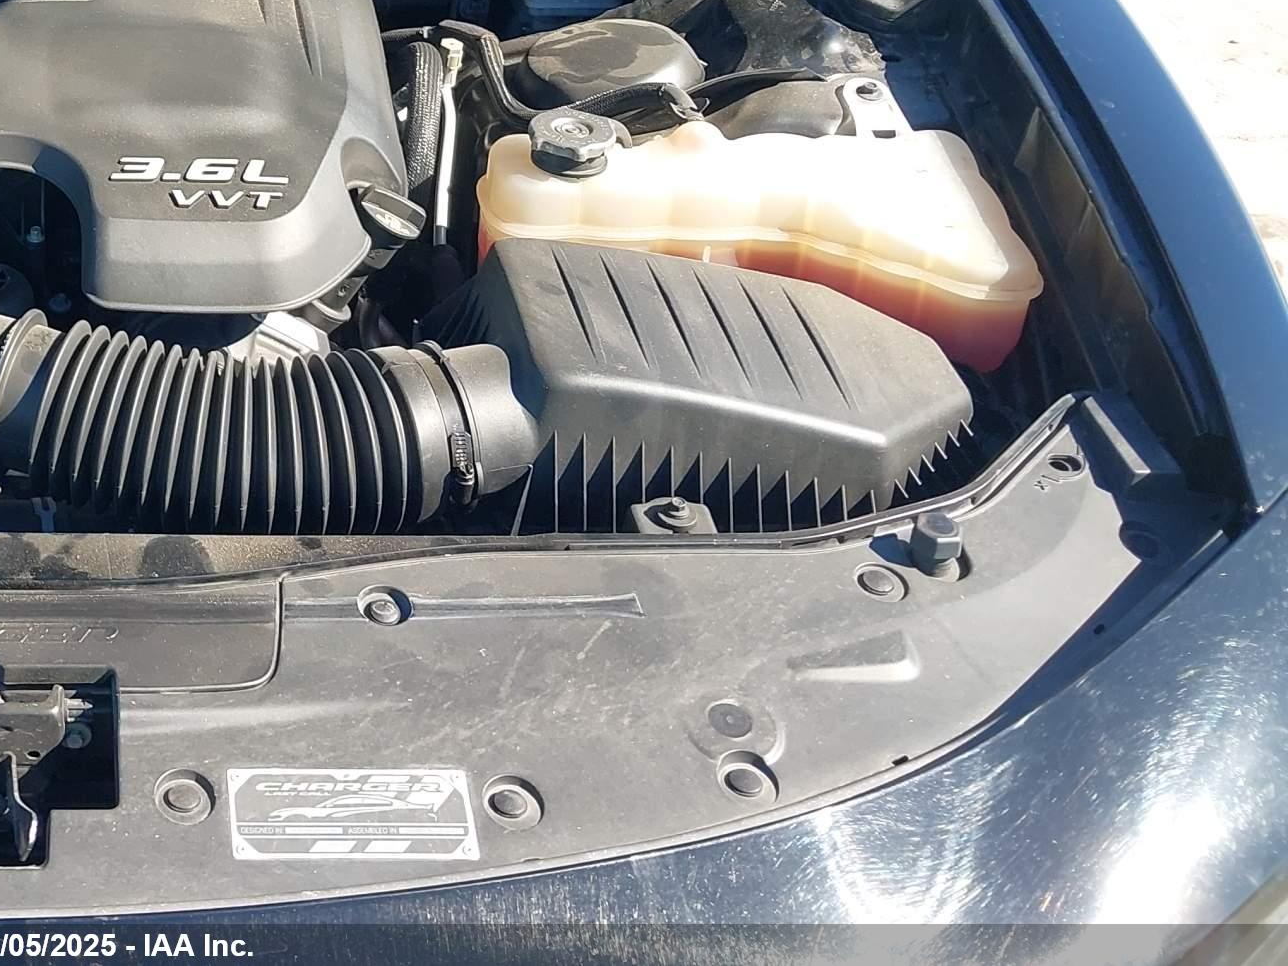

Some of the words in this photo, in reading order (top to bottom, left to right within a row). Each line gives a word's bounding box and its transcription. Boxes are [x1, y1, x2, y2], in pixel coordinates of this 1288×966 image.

[108, 156, 290, 185] 3.6L
[168, 189, 284, 210] VVT
[255, 782, 443, 792] CHARGER
